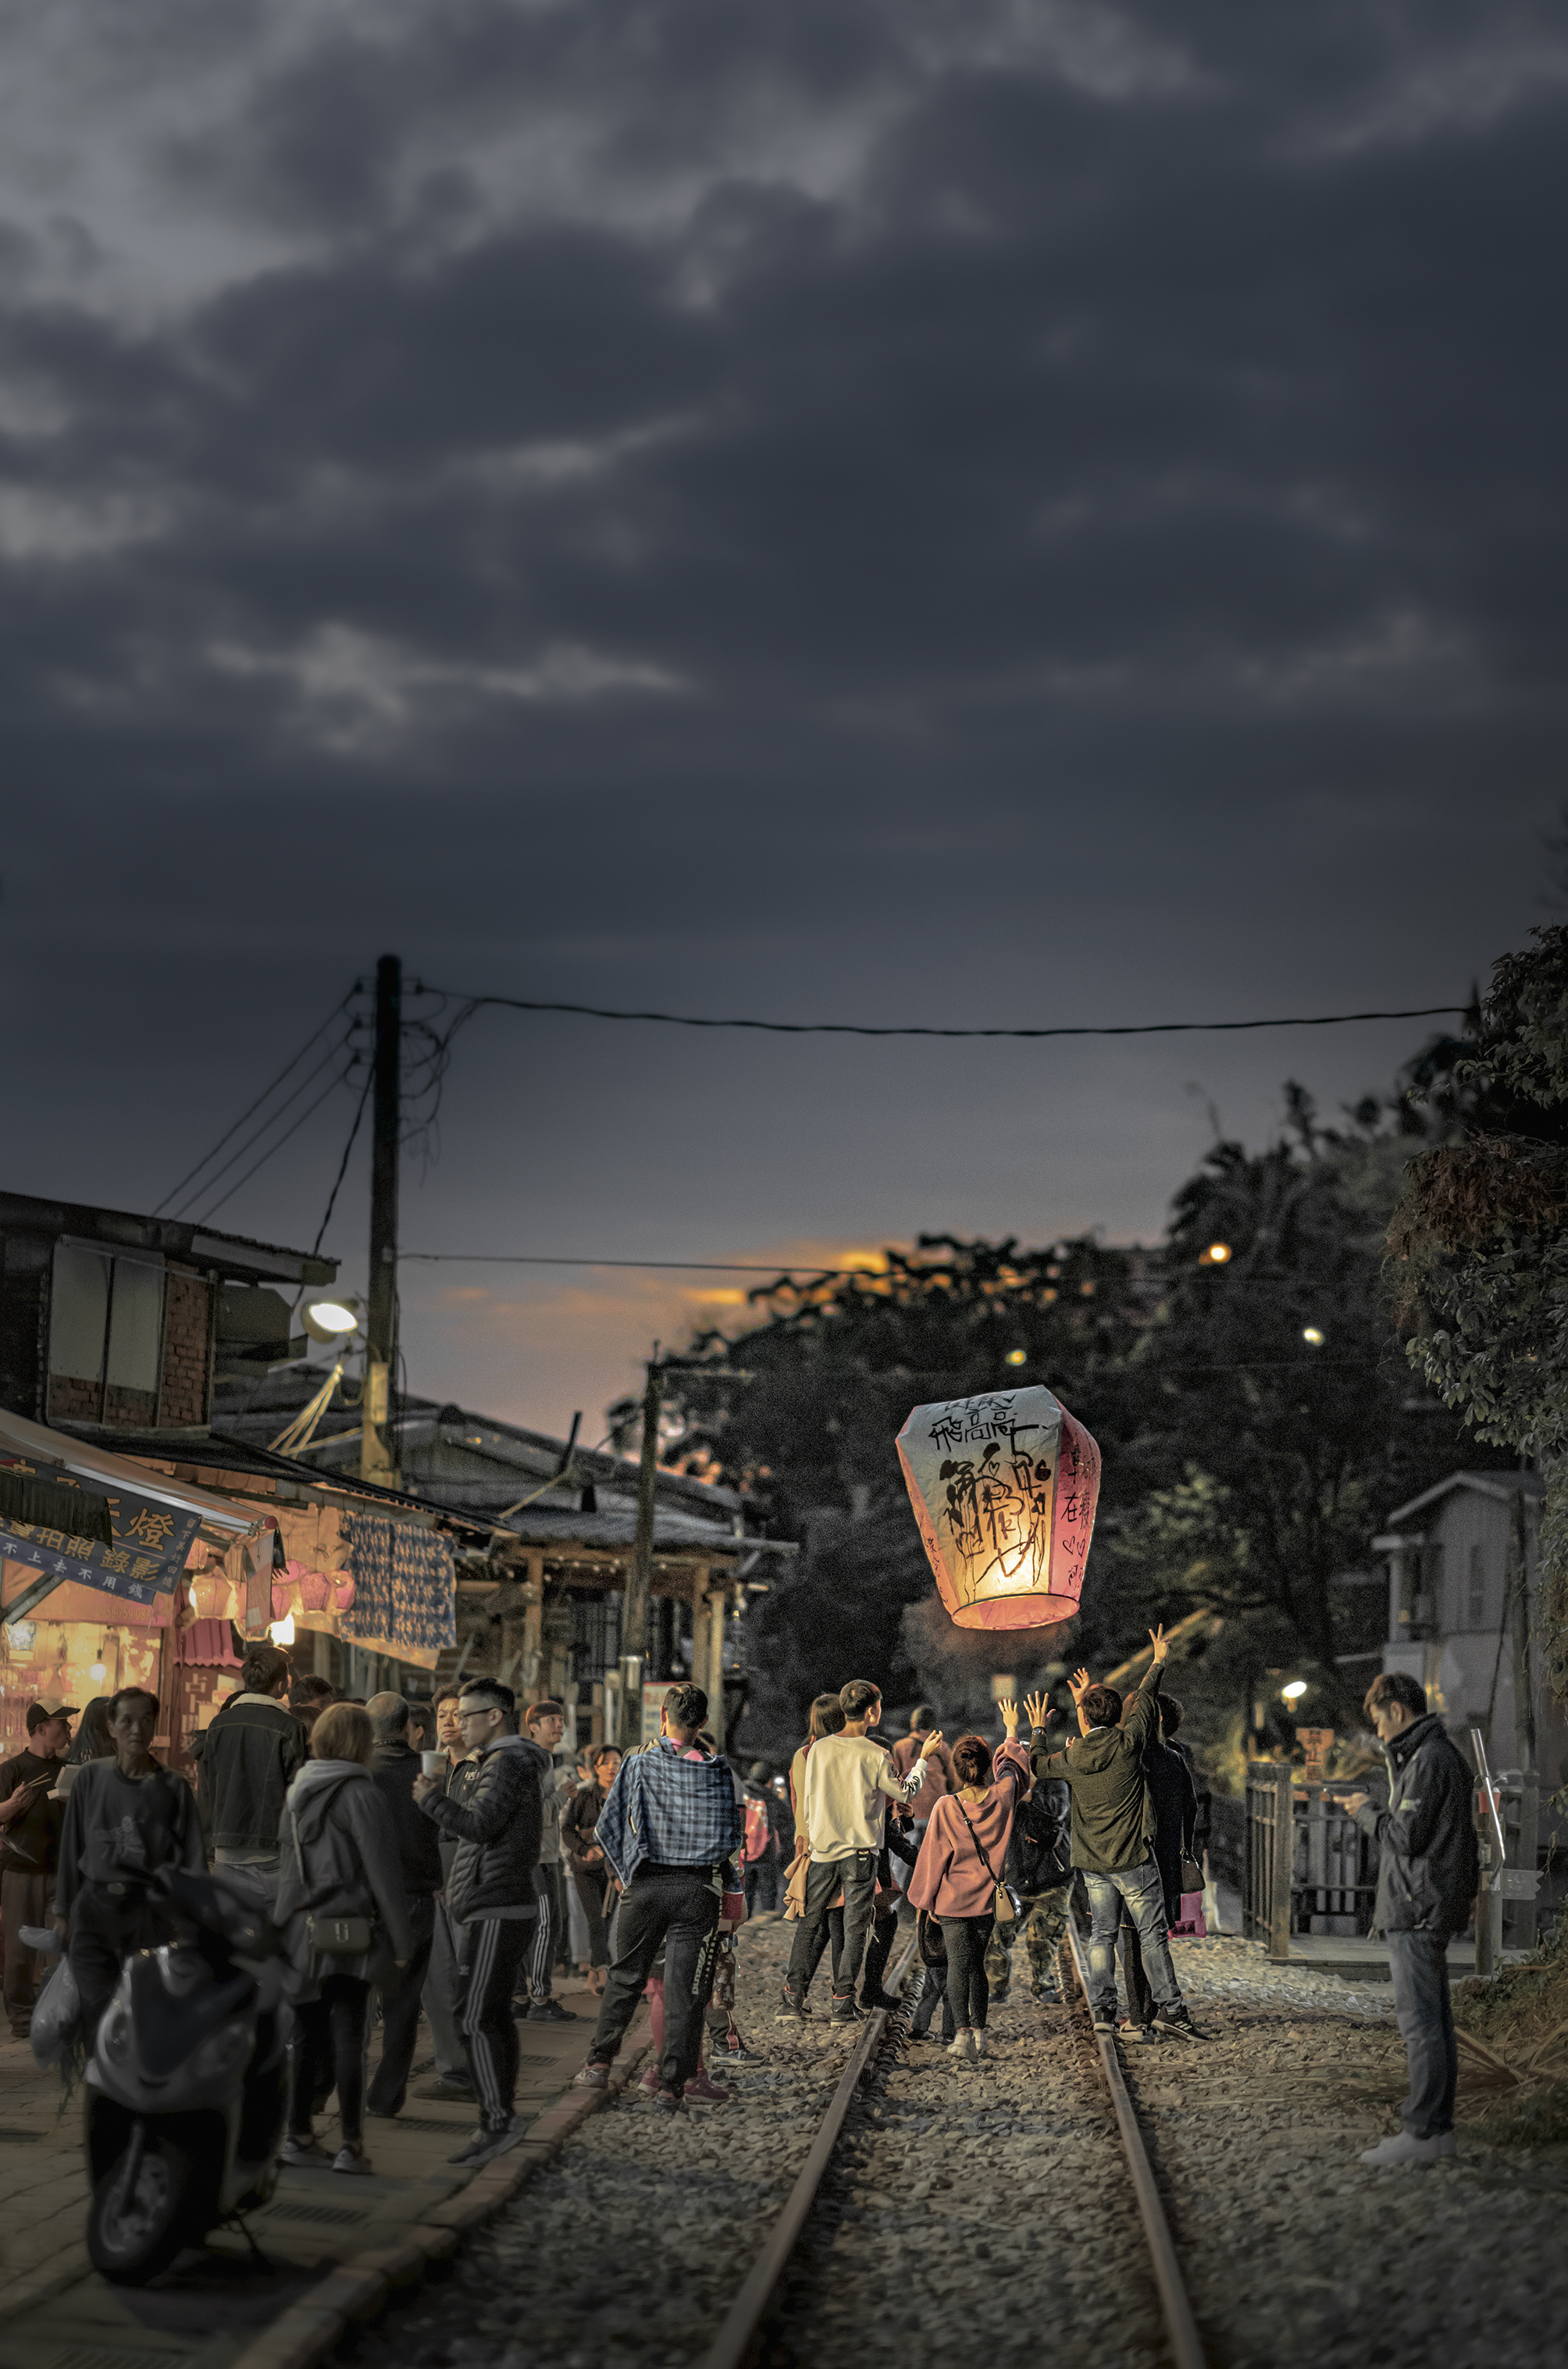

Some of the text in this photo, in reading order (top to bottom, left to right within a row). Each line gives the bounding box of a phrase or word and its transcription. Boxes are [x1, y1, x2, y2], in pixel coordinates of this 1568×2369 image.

[0, 1518, 161, 1582] 費拍照 錄影
[162, 1518, 197, 1588] 留下美好回憶
